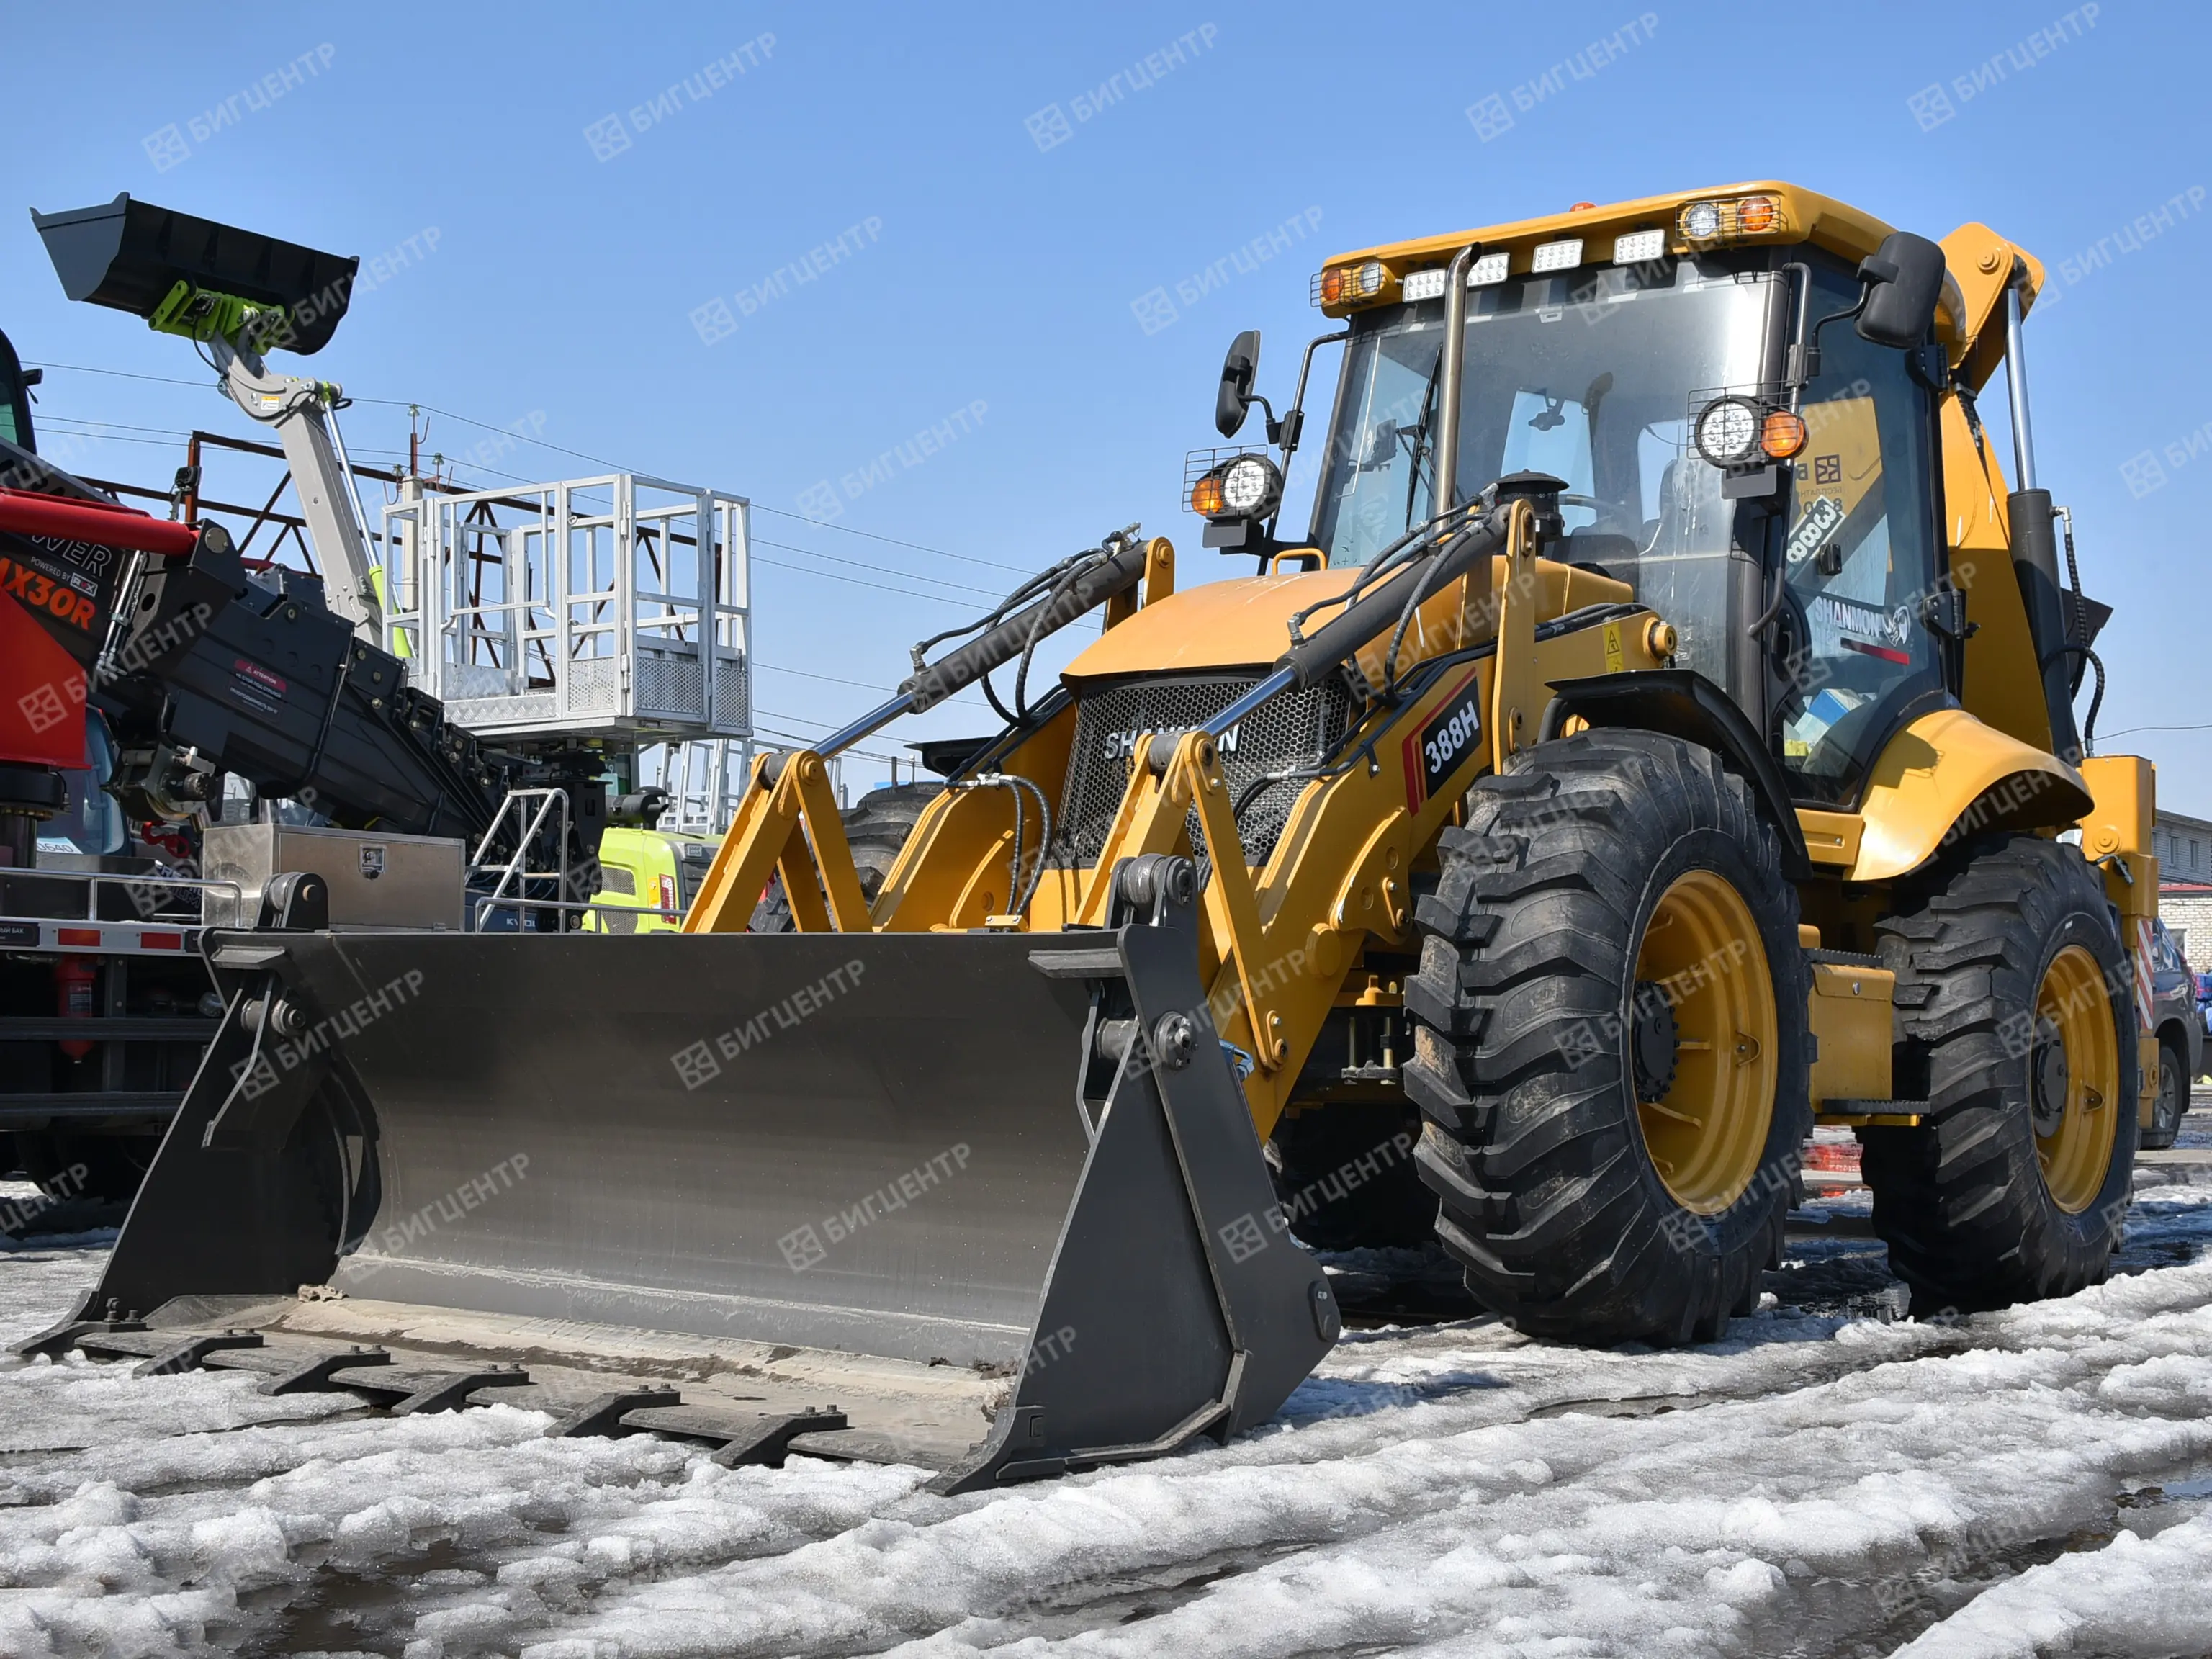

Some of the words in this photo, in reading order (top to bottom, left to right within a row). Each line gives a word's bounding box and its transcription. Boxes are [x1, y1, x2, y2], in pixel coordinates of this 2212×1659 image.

[31, 556, 61, 577] POWERED
[62, 572, 71, 582] BY
[1814, 595, 1880, 638] SHANMON
[1425, 700, 1480, 774] 388H
